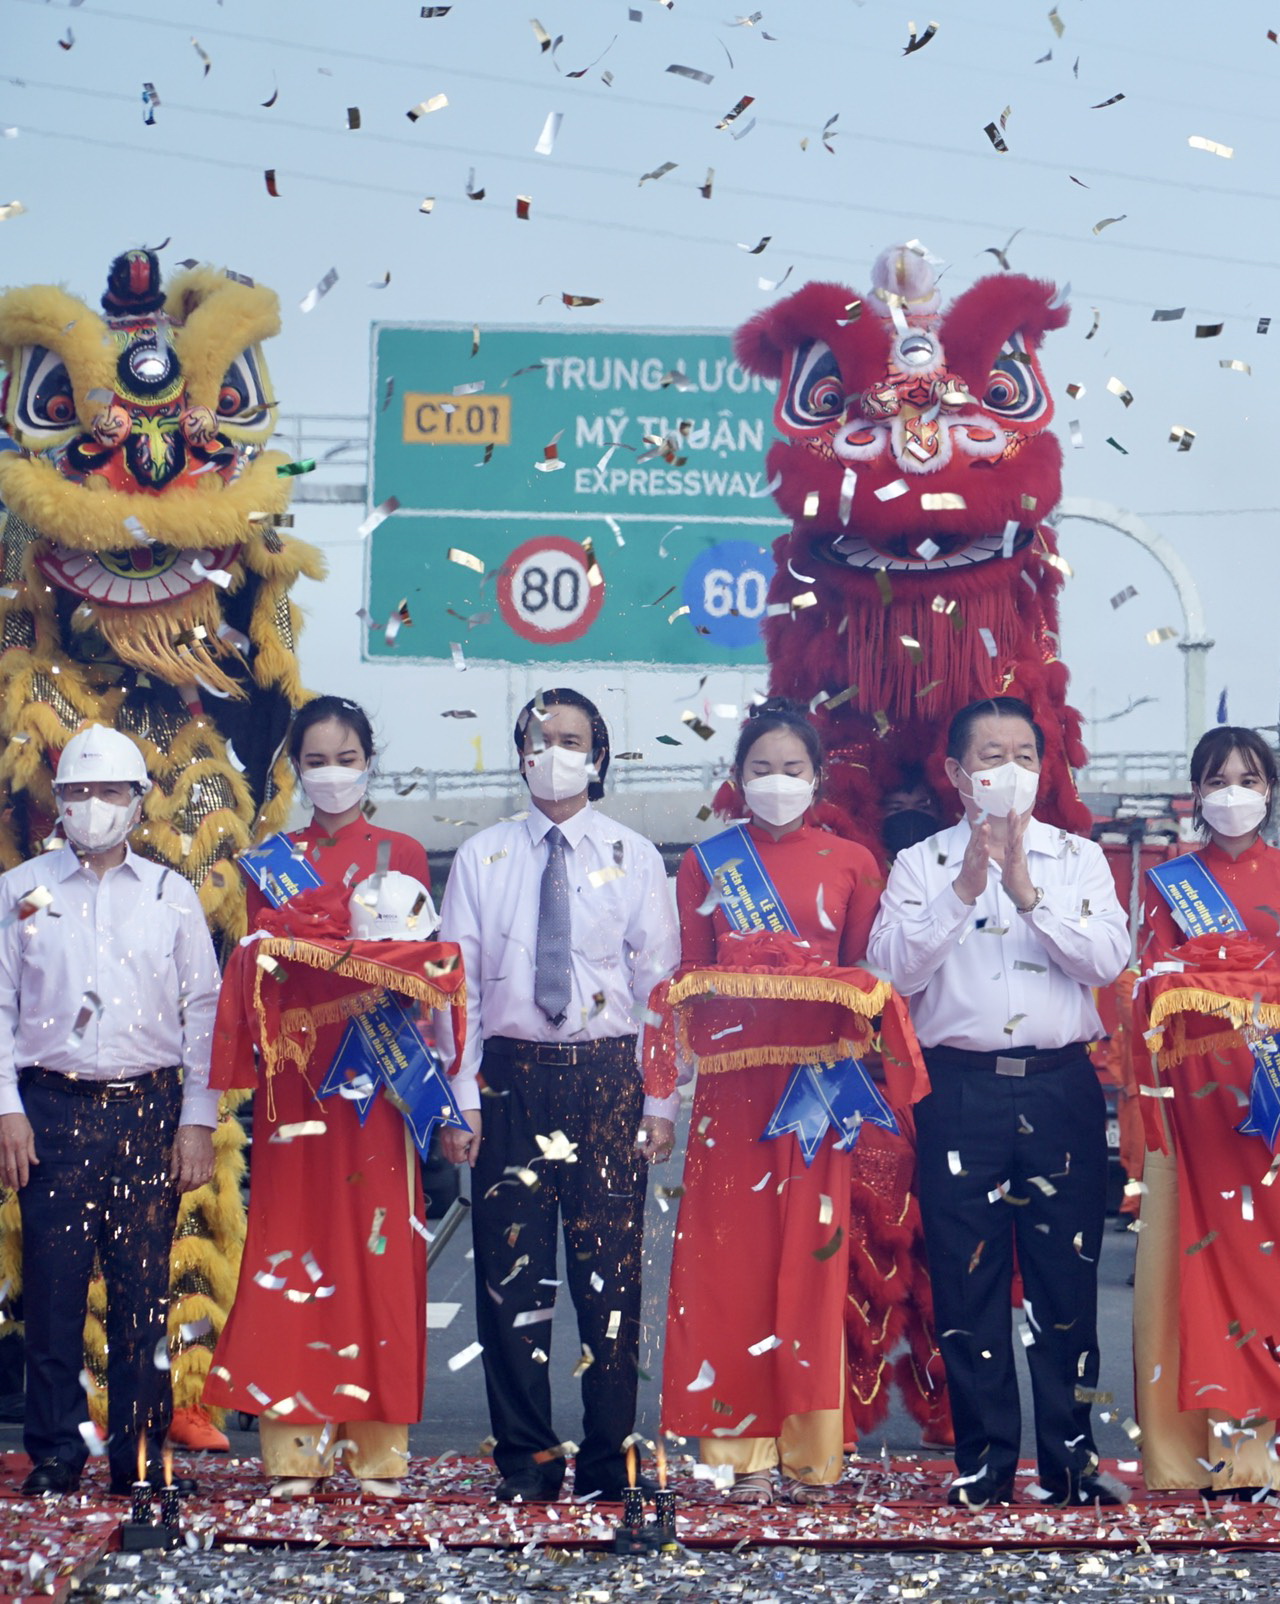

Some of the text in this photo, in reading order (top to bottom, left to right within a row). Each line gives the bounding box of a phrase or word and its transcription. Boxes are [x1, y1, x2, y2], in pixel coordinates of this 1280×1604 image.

[541, 357, 663, 391] TRUNG
[415, 403, 501, 435] CT.01
[575, 407, 763, 459] MỸ THUẬN
[574, 468, 763, 497] EXPRESSWAY
[521, 566, 580, 613] 80
[703, 568, 769, 619] 60
[381, 1055, 396, 1075] 2022
[1269, 1068, 1280, 1088] 2022
